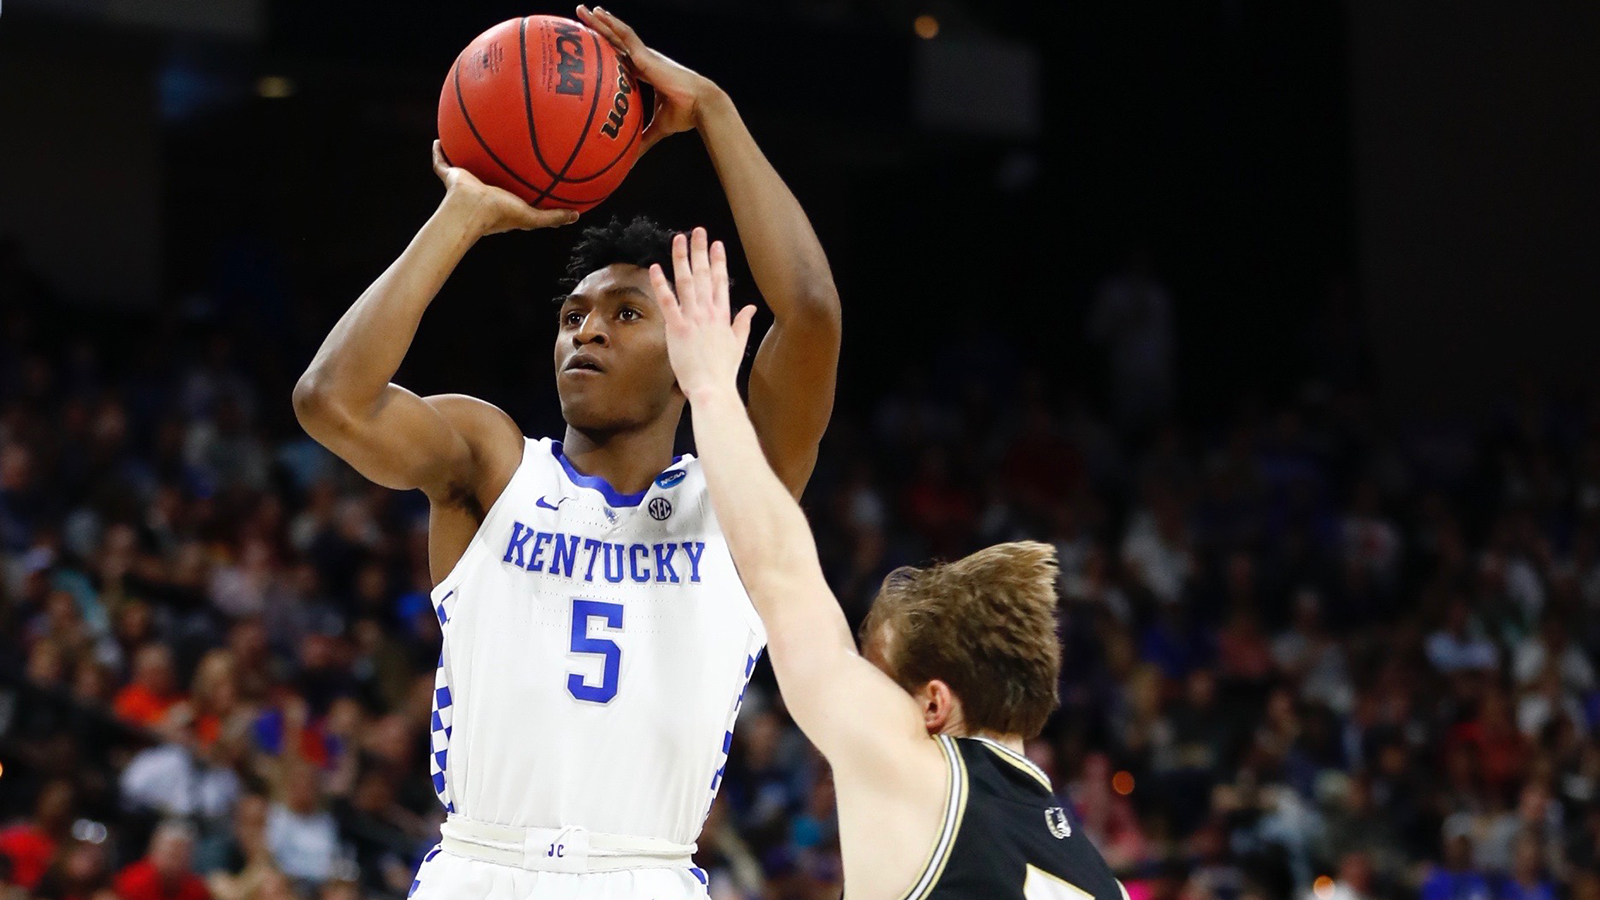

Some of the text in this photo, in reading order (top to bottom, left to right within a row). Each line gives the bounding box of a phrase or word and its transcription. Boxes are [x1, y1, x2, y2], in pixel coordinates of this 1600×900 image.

[551, 21, 585, 96] NCAA
[649, 498, 671, 520] SEC
[660, 471, 686, 487] NCAA
[502, 520, 706, 585] KENTUCKY
[564, 597, 626, 706] 5
